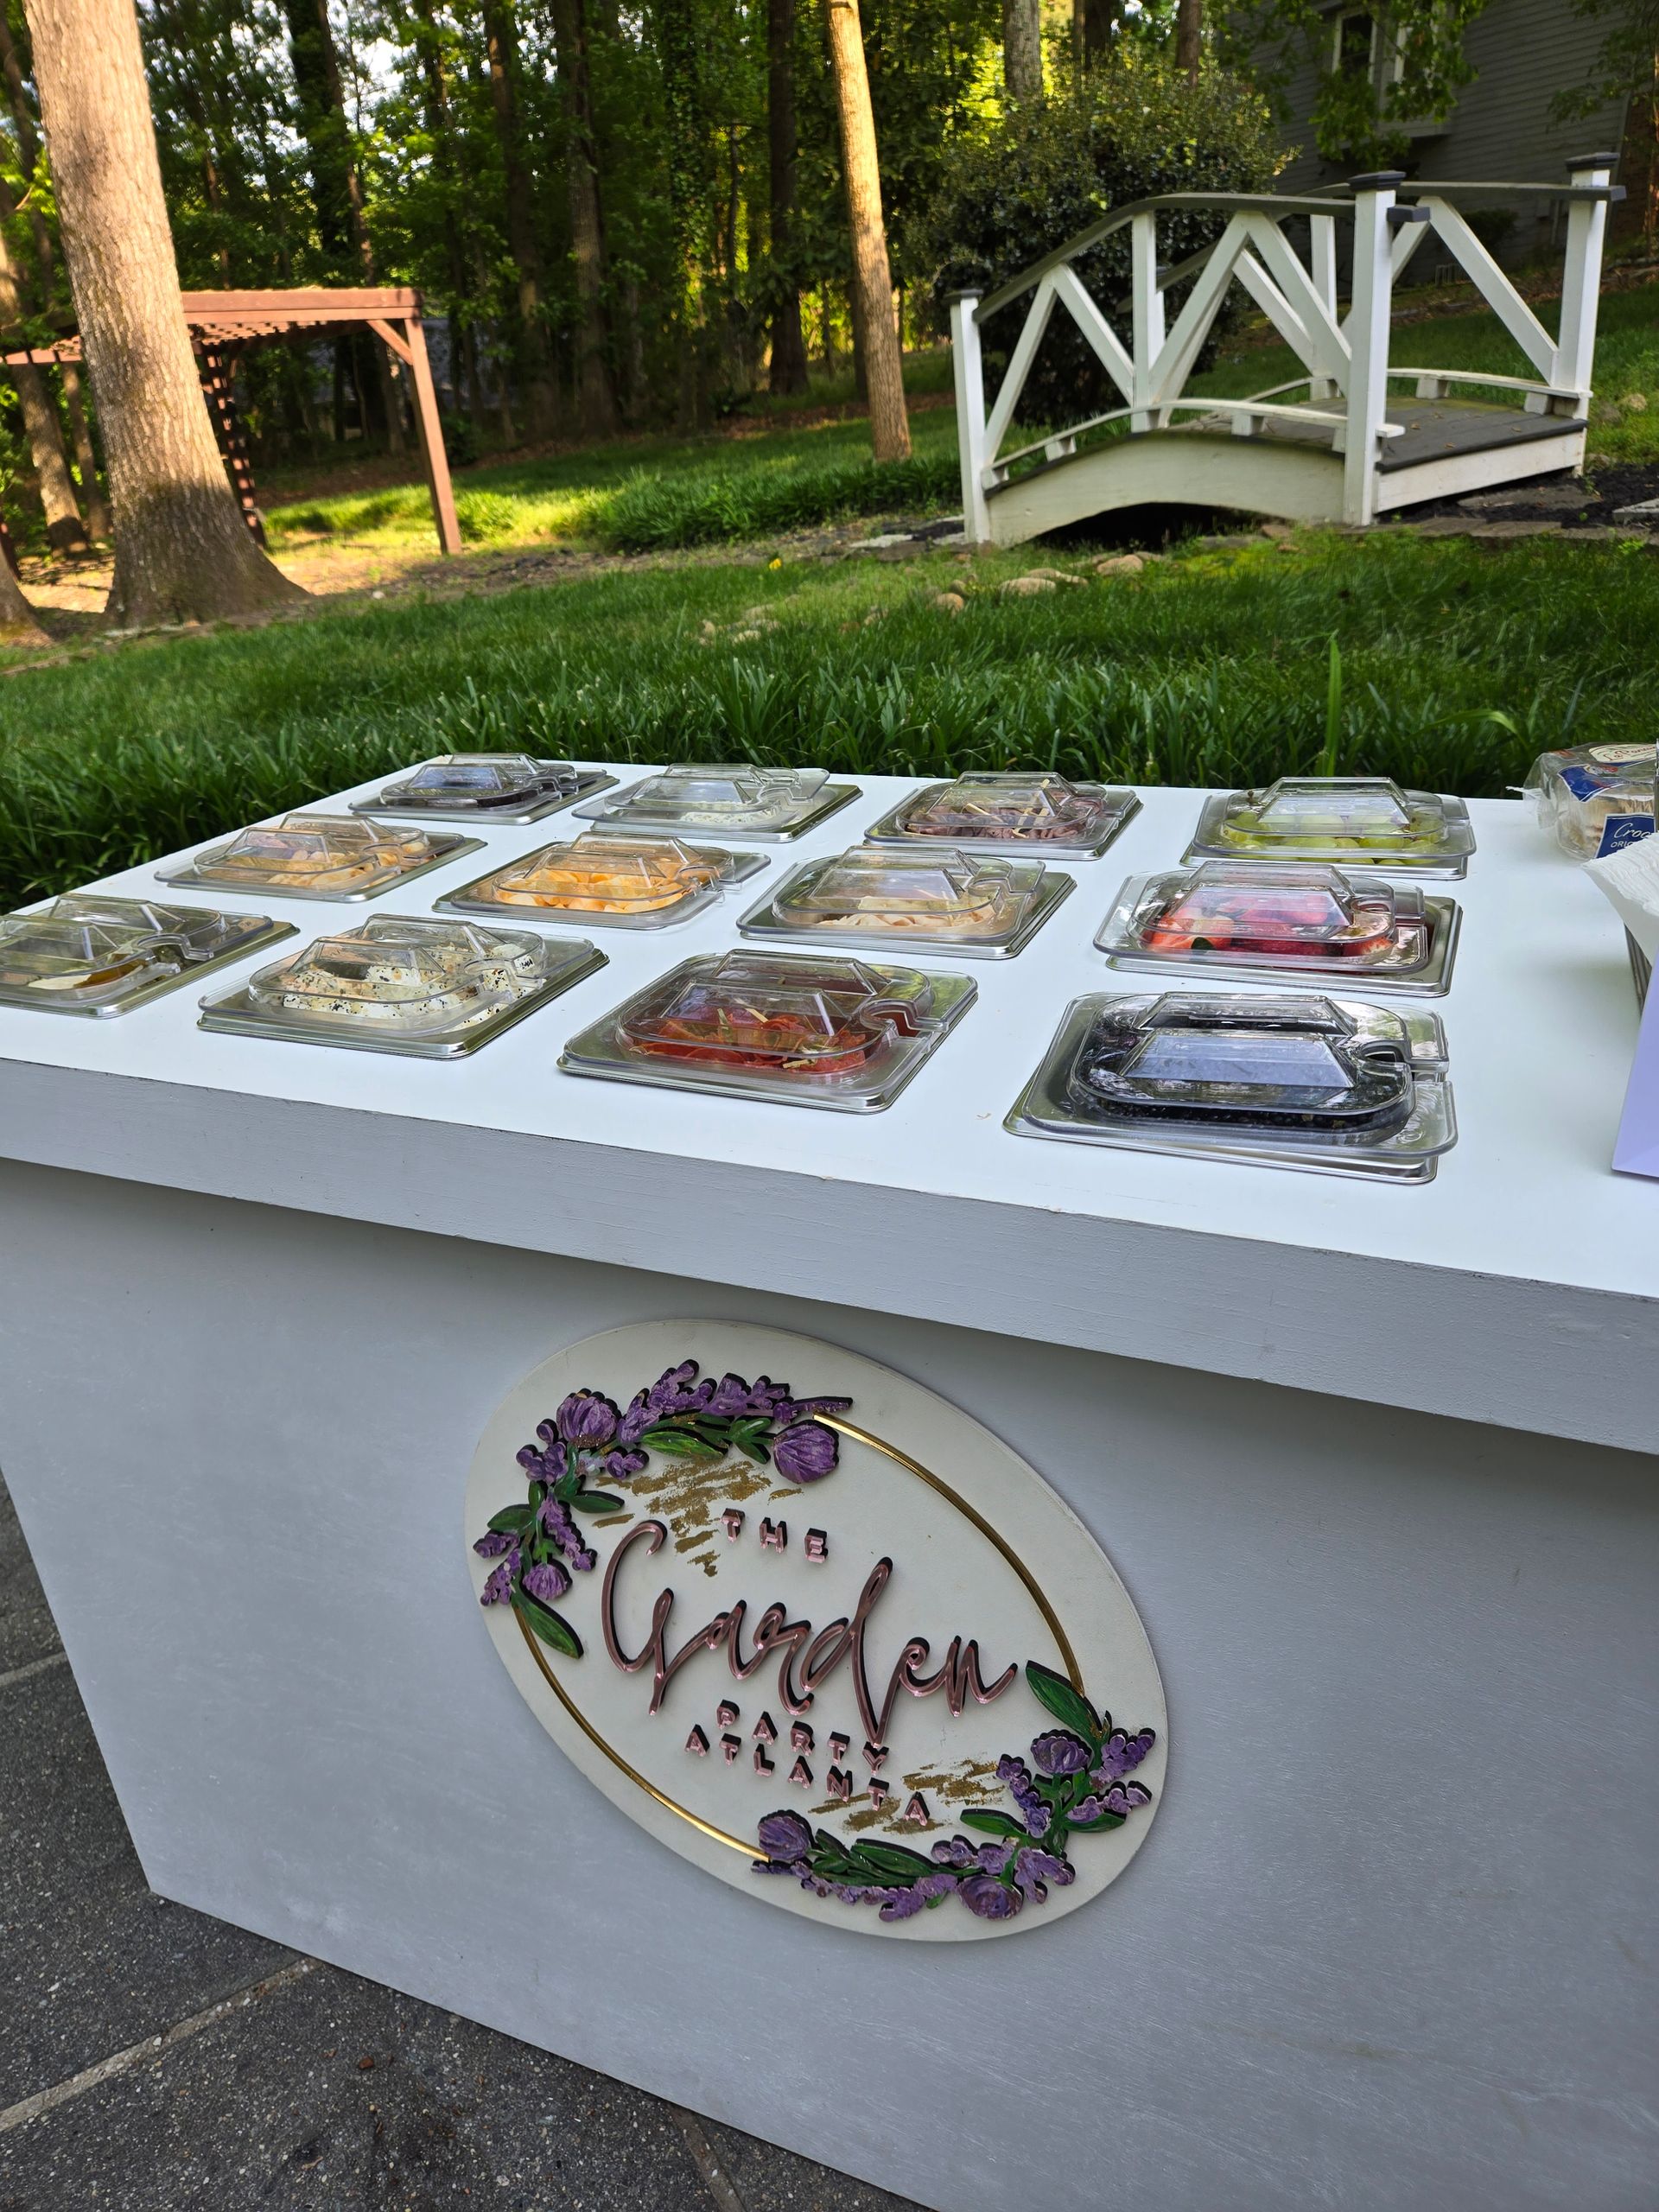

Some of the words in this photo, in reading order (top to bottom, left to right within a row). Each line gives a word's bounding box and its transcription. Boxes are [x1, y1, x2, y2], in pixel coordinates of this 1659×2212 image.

[720, 1507, 829, 1564] THE
[601, 1520, 1018, 1748] Garden
[684, 1724, 931, 1826] ATLANTA
[715, 1699, 890, 1776] PARTY
